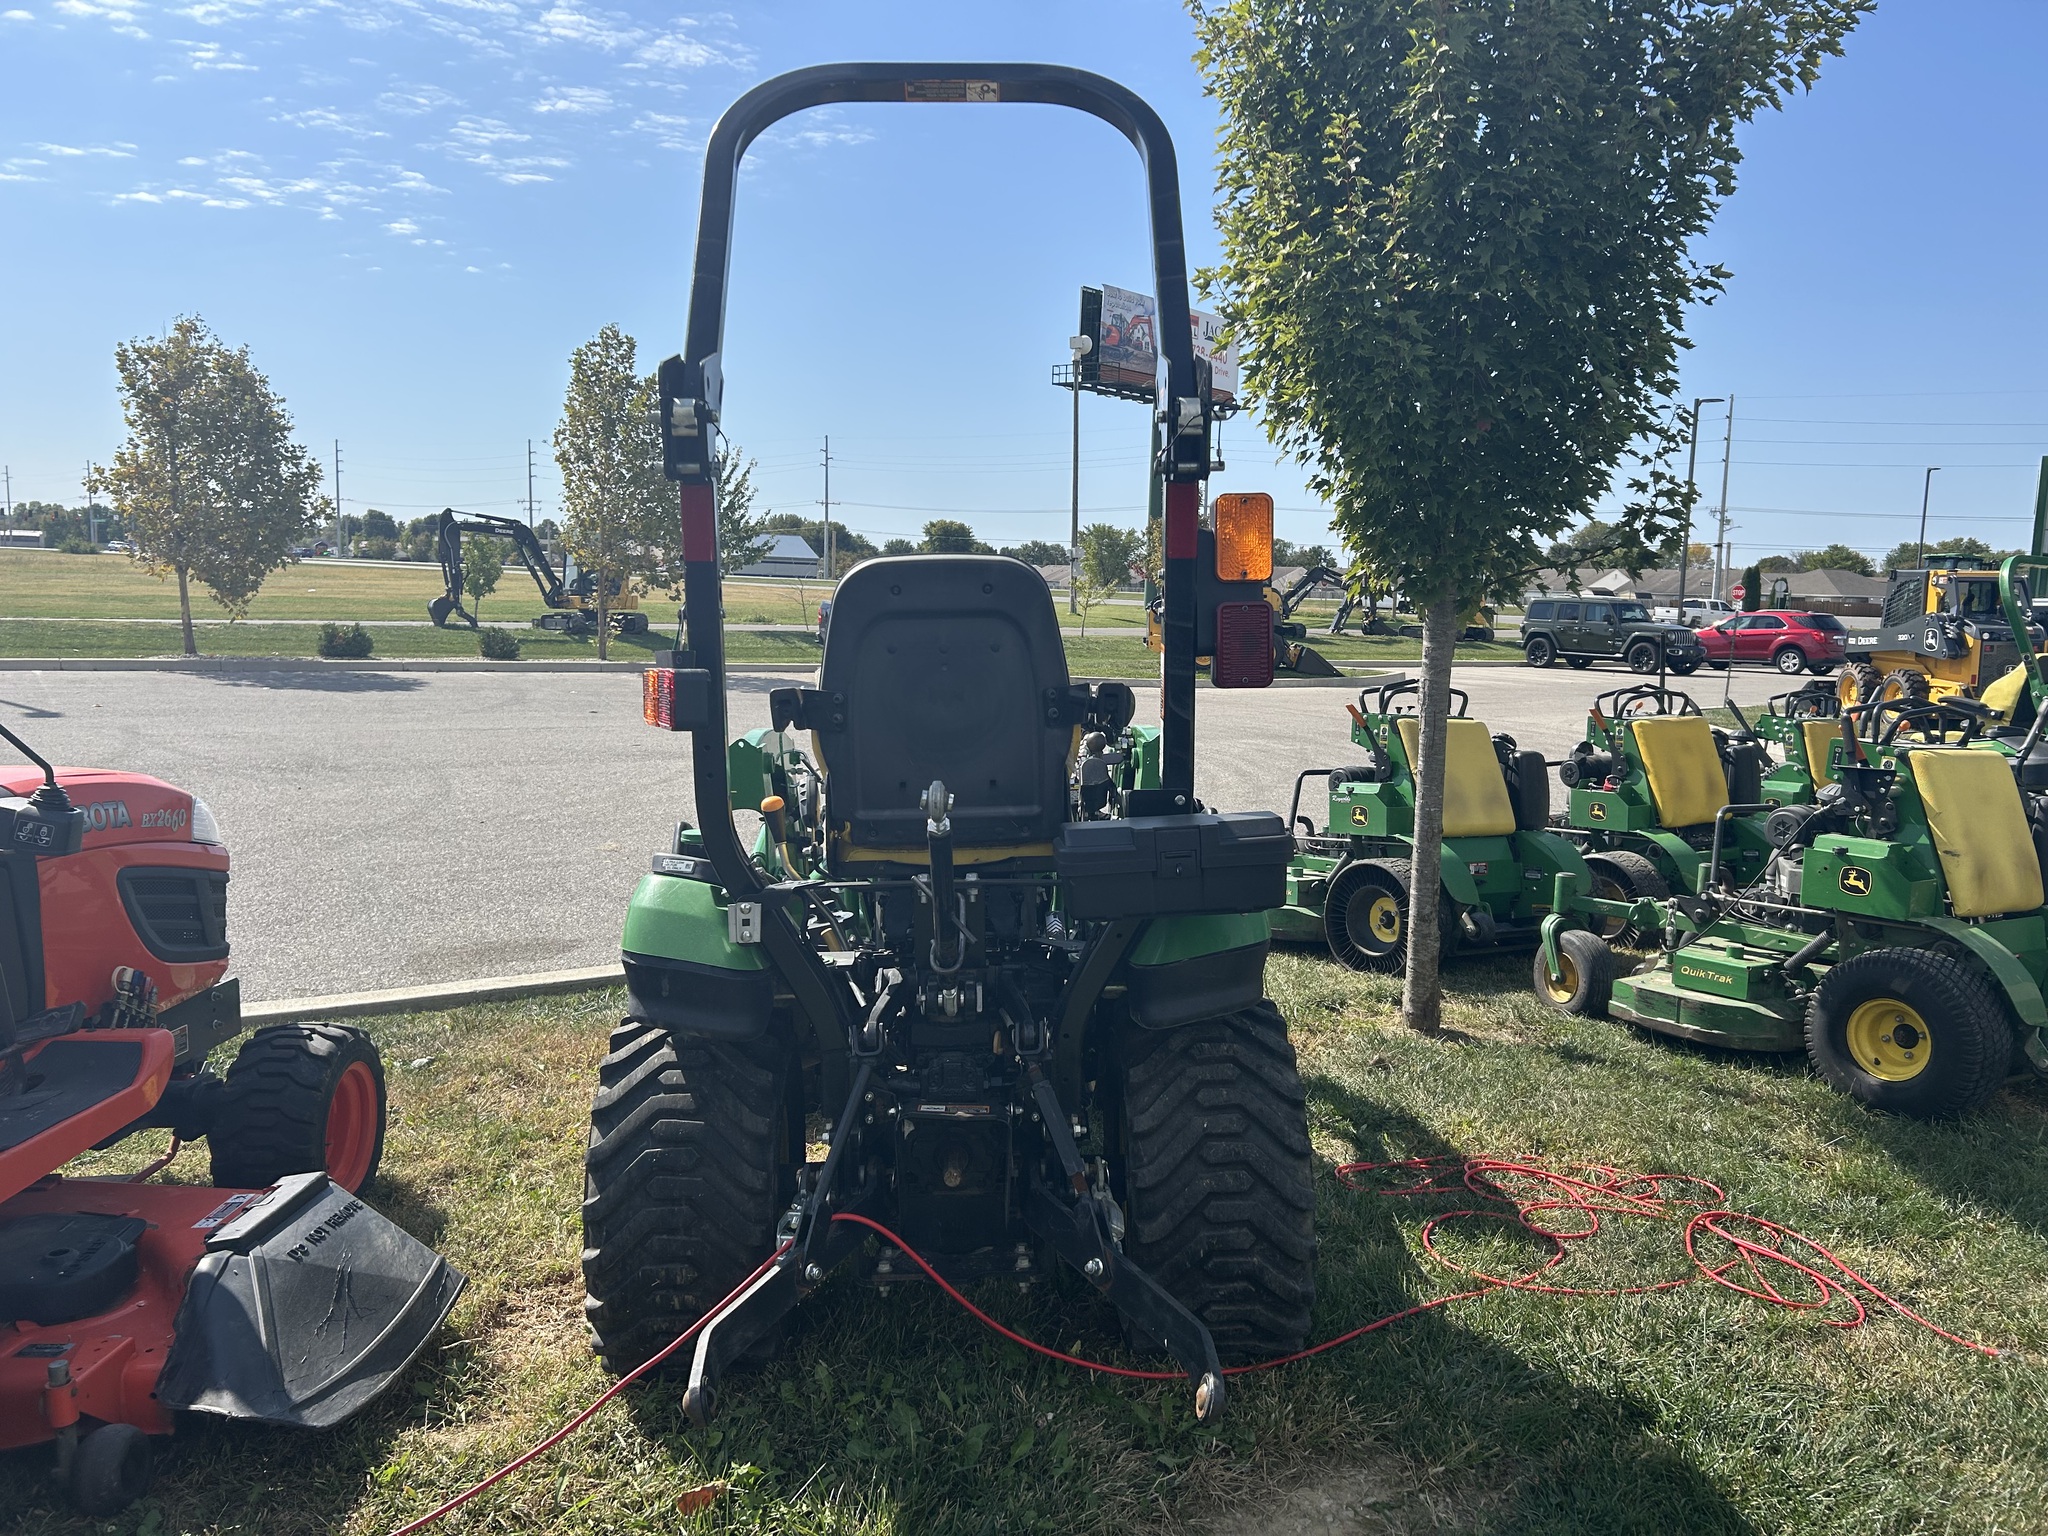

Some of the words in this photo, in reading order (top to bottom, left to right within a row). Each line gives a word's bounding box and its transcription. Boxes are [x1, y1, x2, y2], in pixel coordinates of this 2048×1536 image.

[494, 527, 514, 535] DEERE
[1857, 636, 1878, 645] DEERE
[286, 1242, 311, 1265] DO
[304, 1225, 332, 1248] NOT
[323, 1199, 365, 1232] REMOVE
